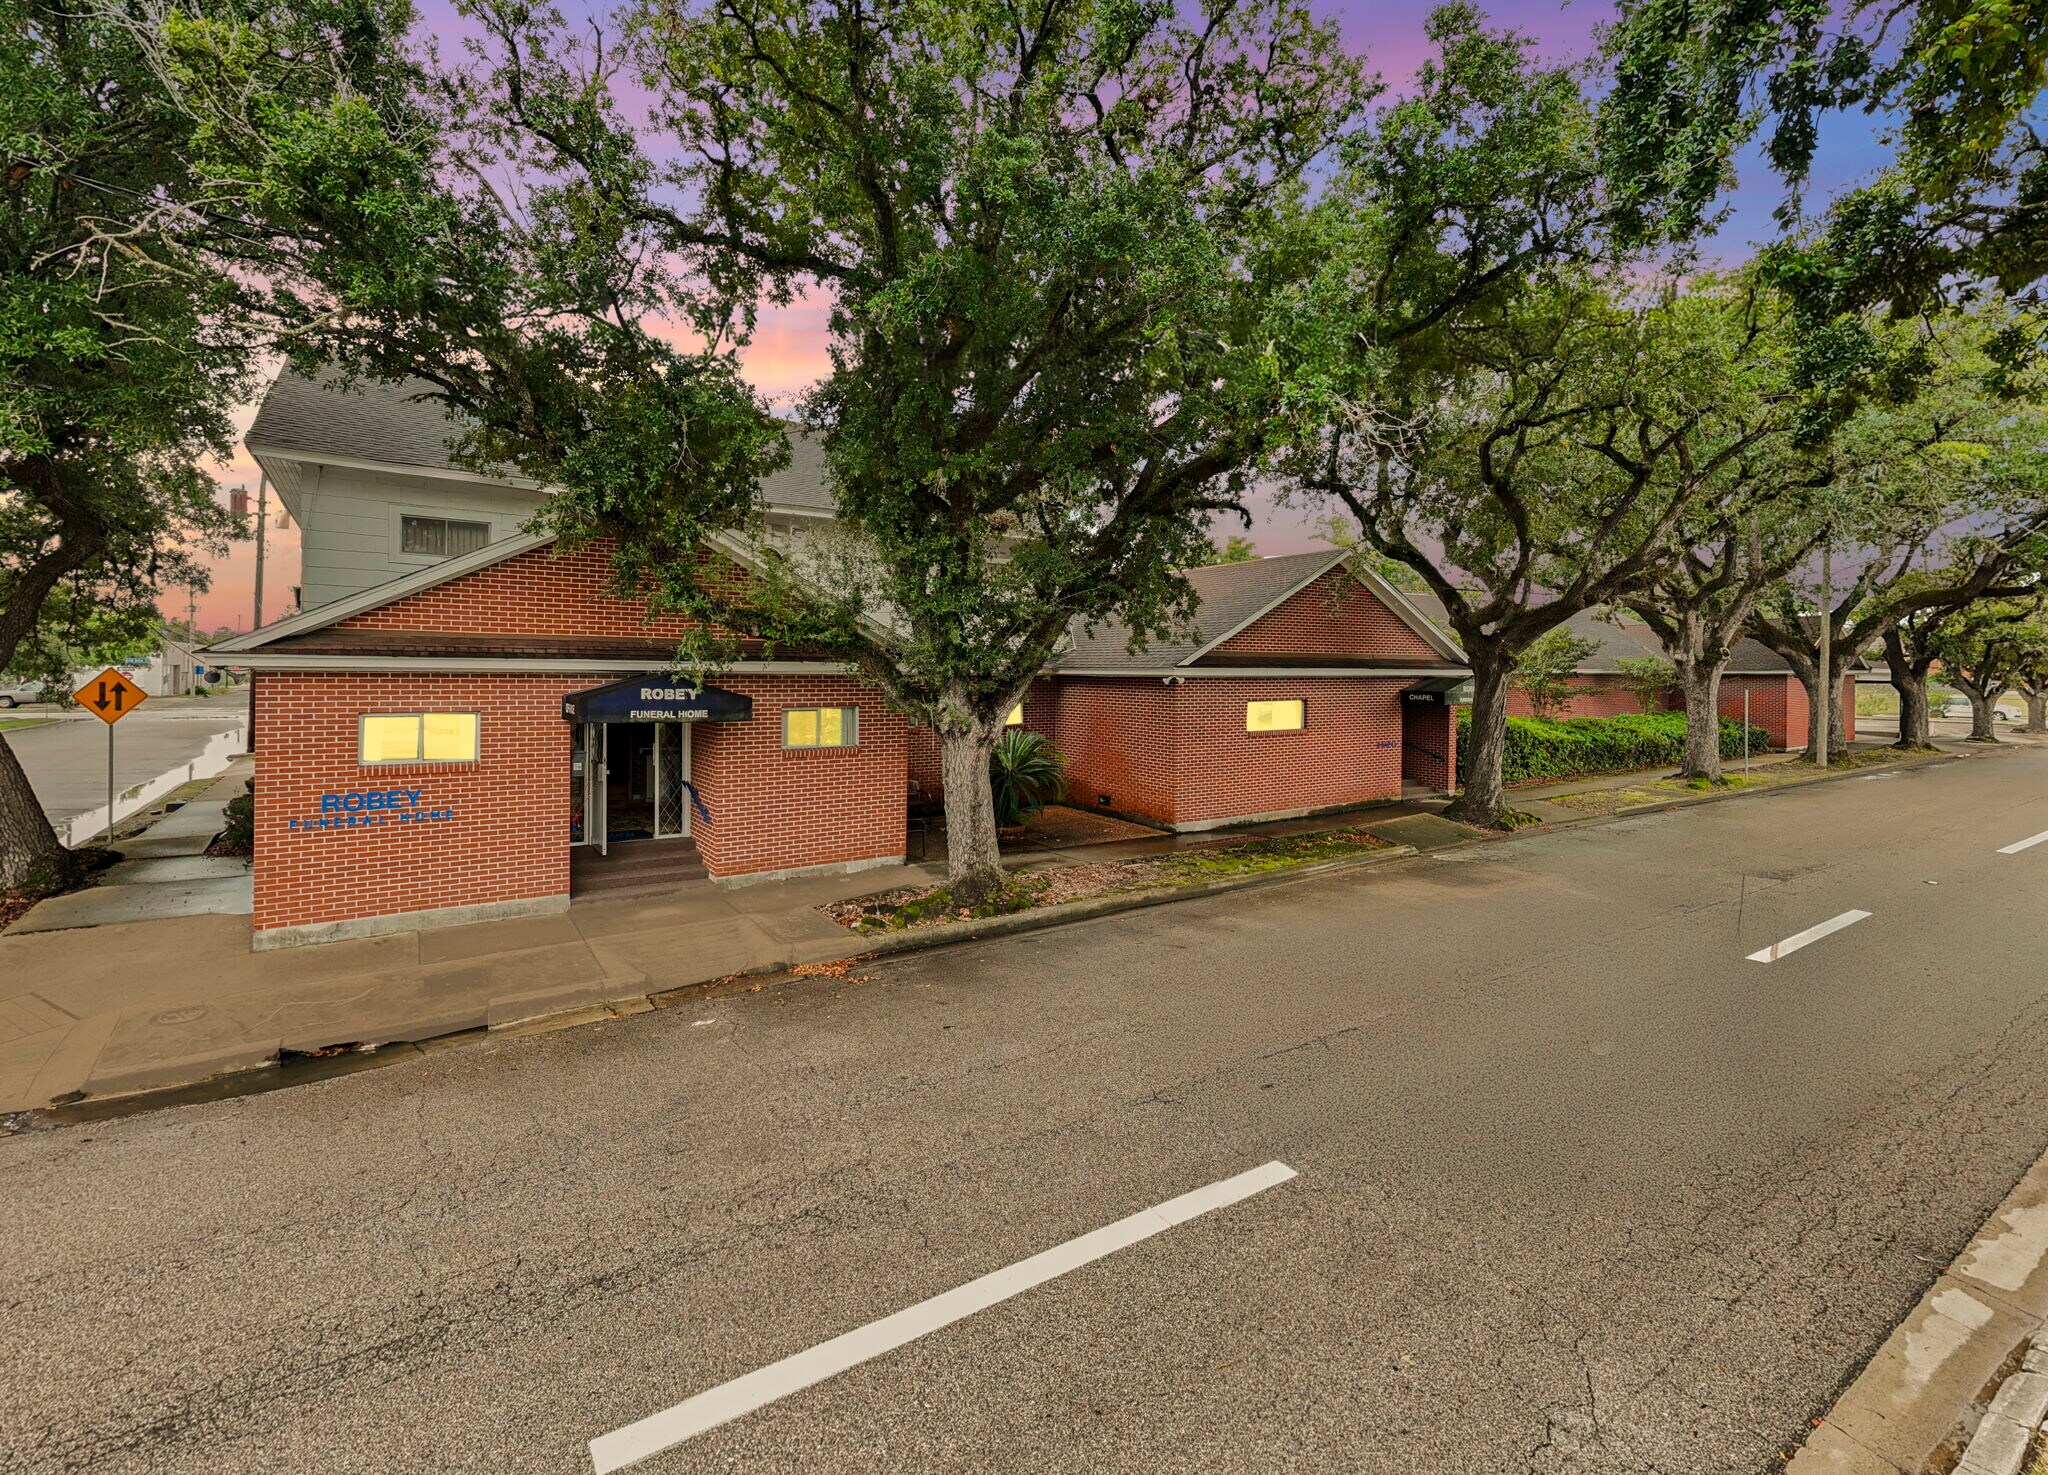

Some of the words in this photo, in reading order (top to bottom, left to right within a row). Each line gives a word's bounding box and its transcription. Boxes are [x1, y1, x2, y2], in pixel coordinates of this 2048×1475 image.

[640, 688, 698, 700] ROBEY
[1408, 693, 1435, 702] CHAPEL
[630, 710, 677, 719] FUNERAL
[678, 709, 709, 718] HOME
[321, 789, 423, 814] ROBEY
[289, 815, 387, 830] FUNERAL
[400, 810, 453, 822] HOME
